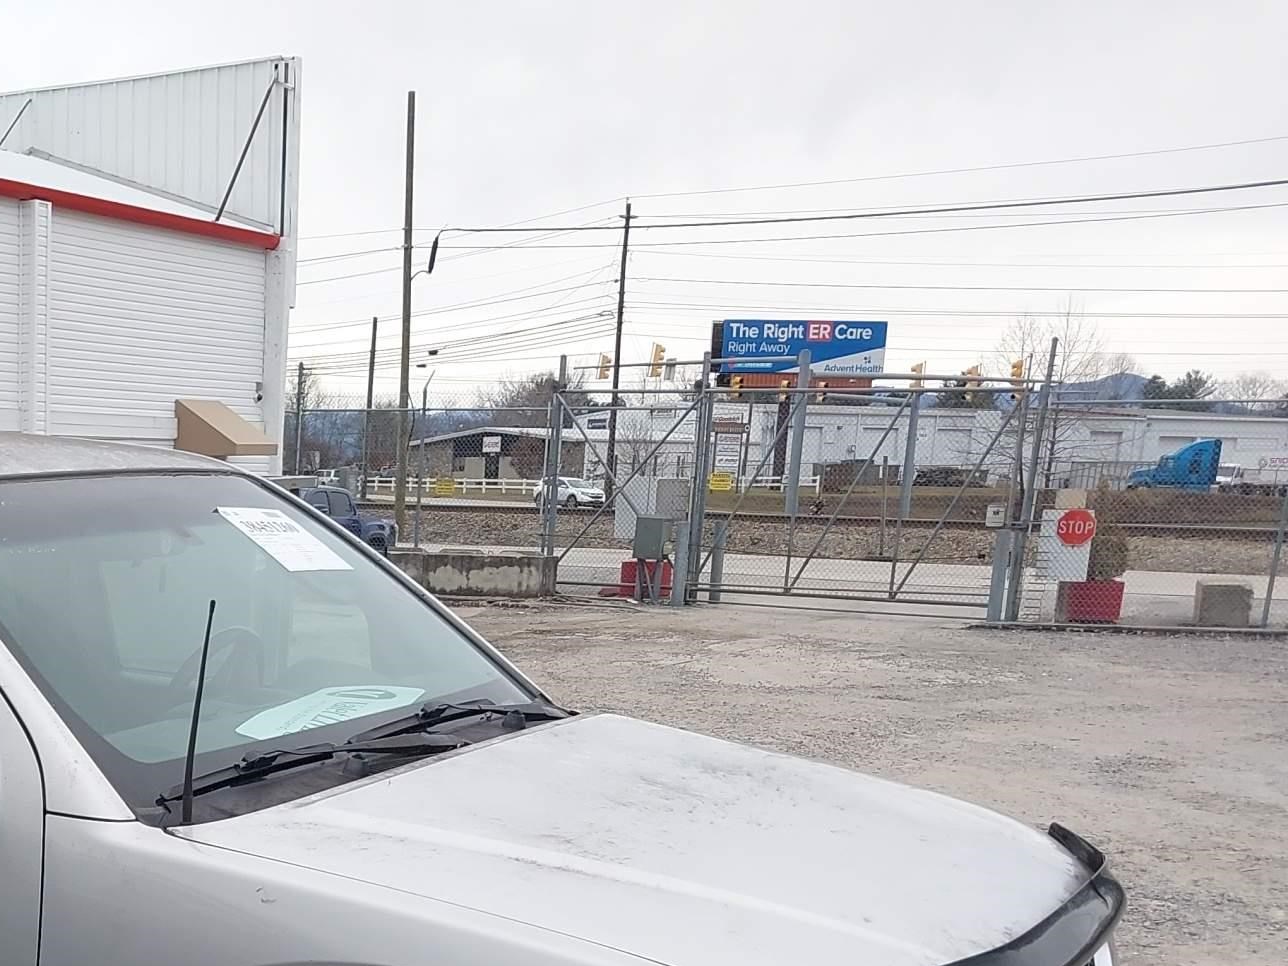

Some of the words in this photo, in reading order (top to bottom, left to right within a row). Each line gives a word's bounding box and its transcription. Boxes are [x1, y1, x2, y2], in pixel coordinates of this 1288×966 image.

[730, 323, 759, 338] The
[763, 323, 804, 342] Right
[808, 323, 831, 339] ER
[834, 323, 873, 340] Care
[728, 341, 756, 355] Right
[759, 342, 791, 357] Away
[1058, 519, 1094, 535] STOP
